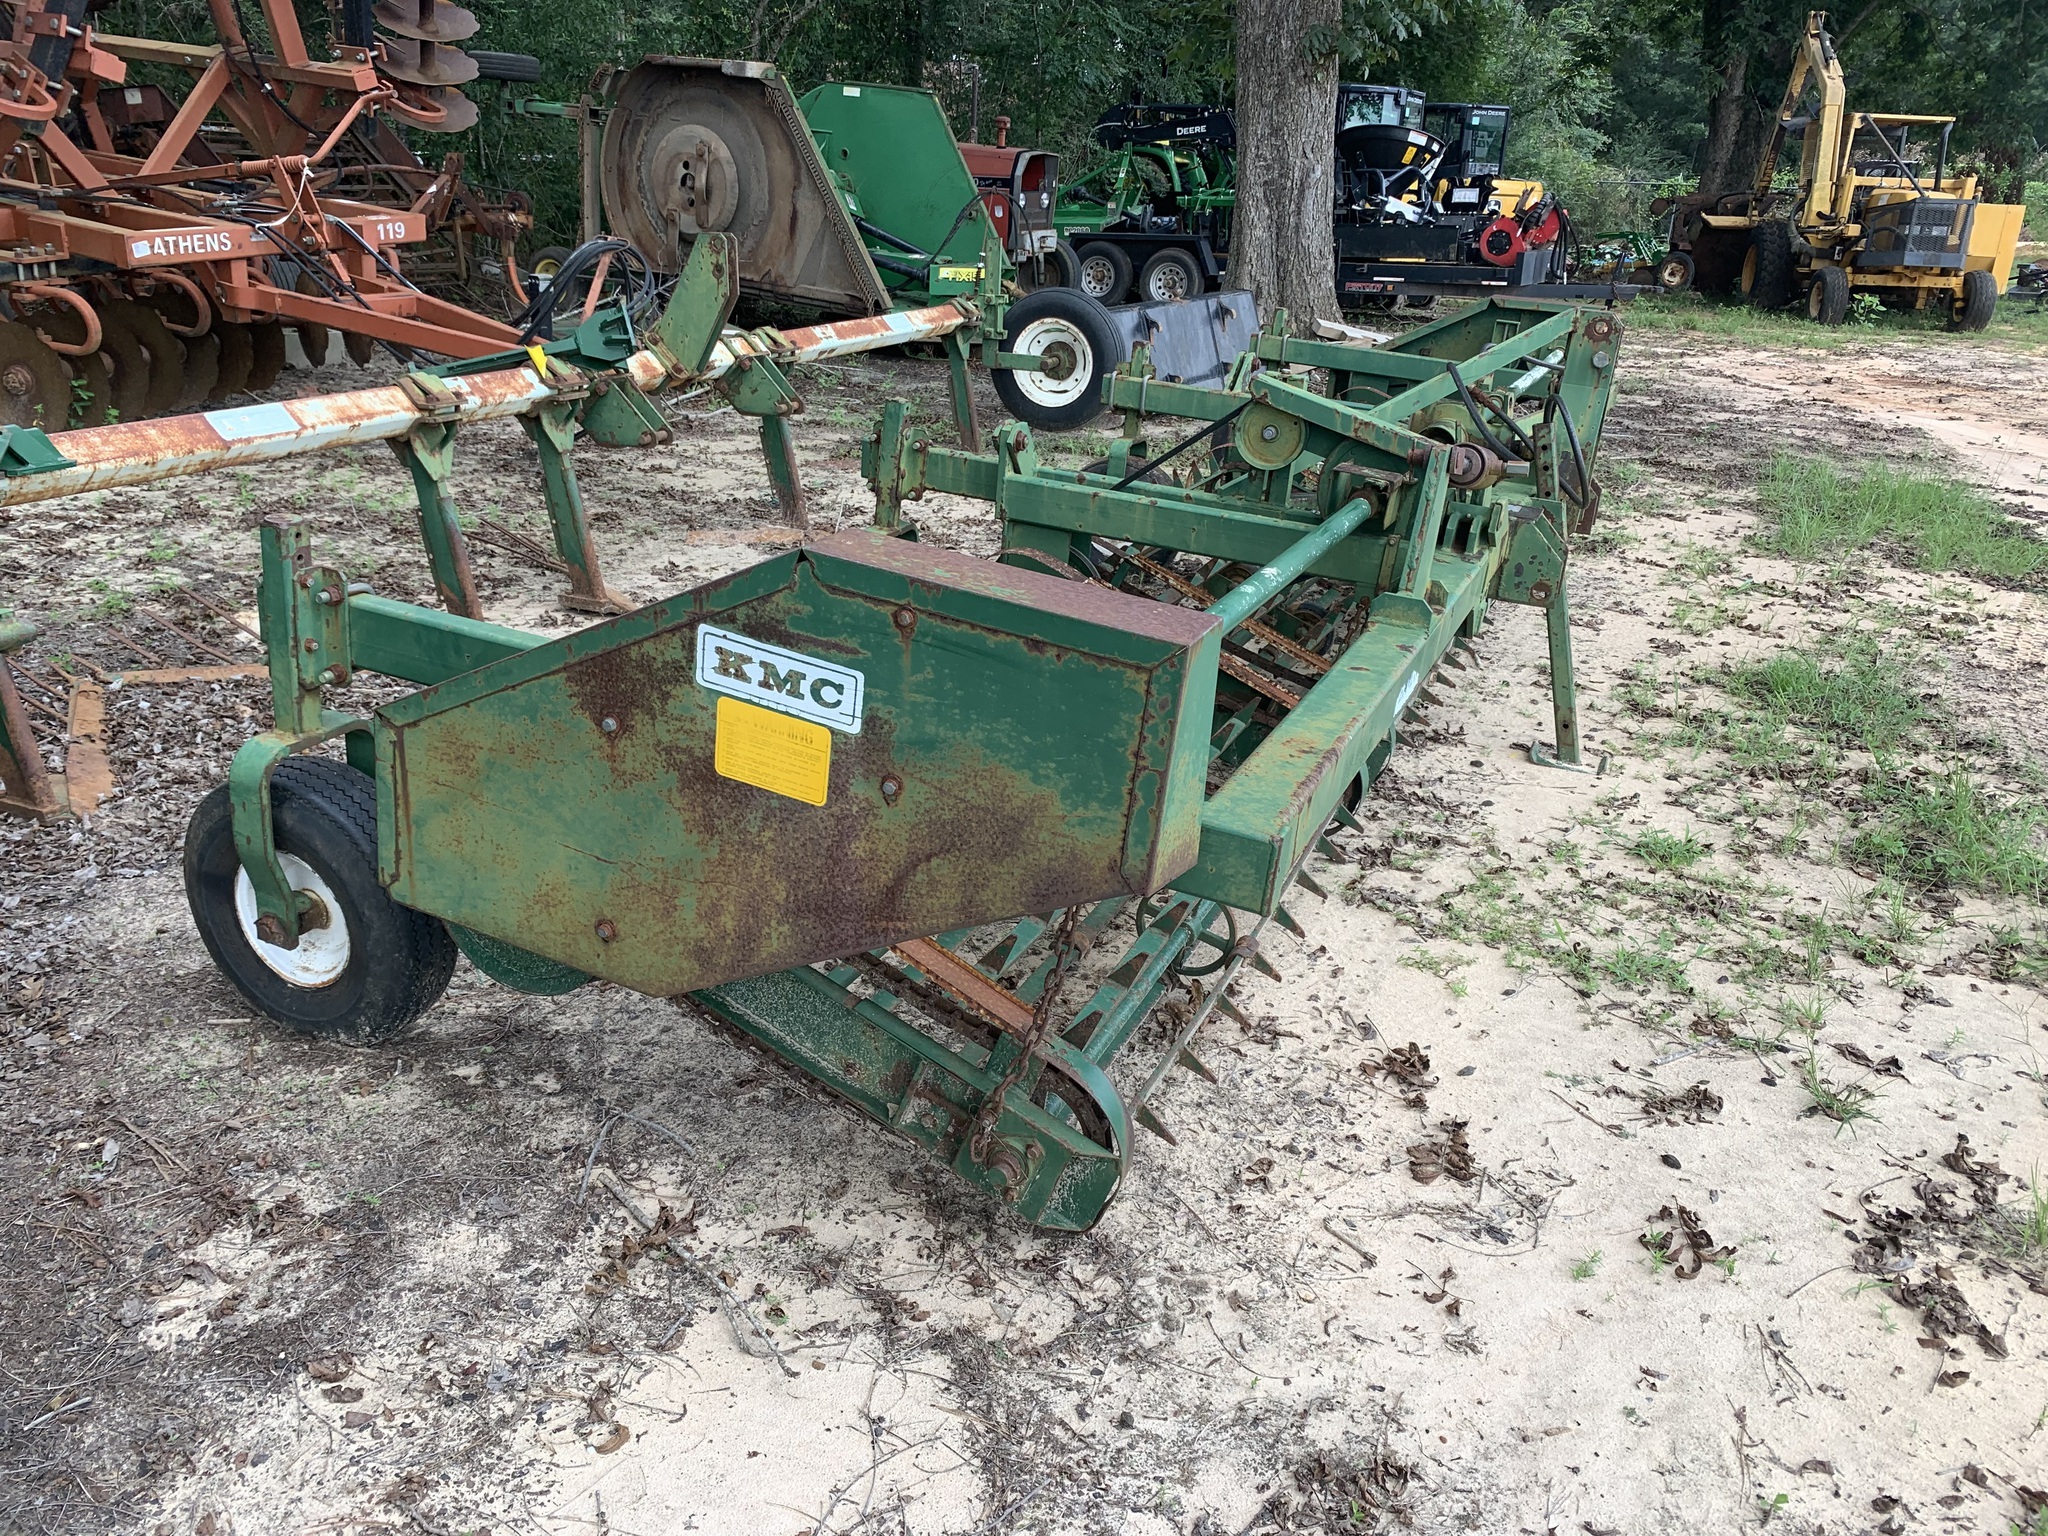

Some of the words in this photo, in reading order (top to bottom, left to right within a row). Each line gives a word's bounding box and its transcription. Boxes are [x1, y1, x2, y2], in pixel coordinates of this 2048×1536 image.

[1176, 125, 1207, 136] DEERE
[153, 232, 232, 257] ATHENS
[377, 222, 406, 241] 119
[713, 646, 845, 709] KMC
